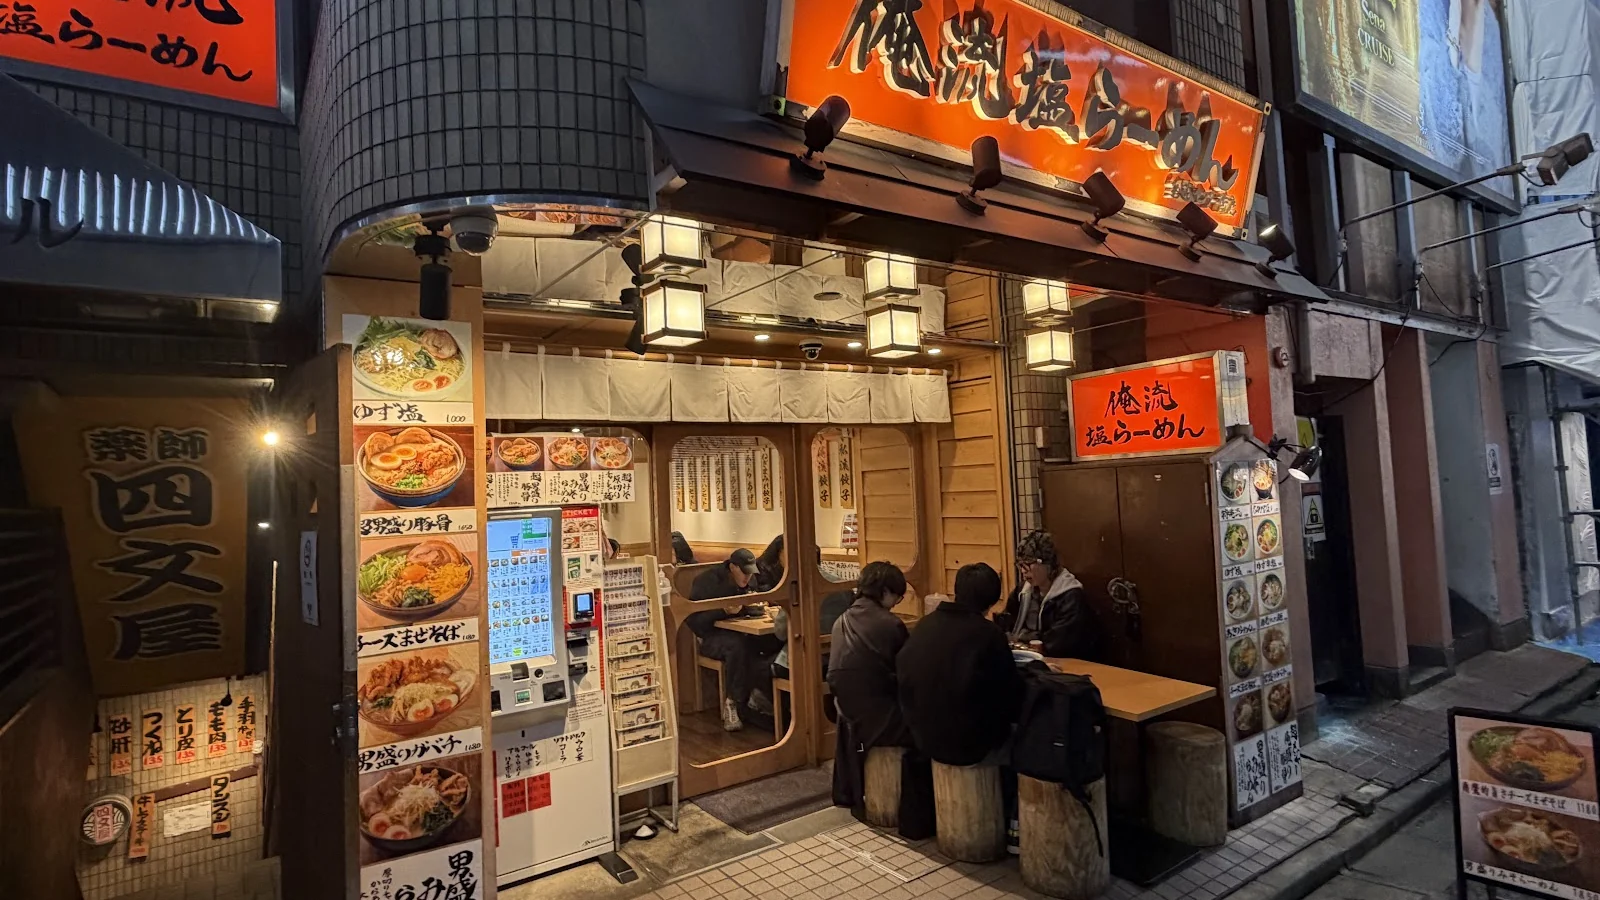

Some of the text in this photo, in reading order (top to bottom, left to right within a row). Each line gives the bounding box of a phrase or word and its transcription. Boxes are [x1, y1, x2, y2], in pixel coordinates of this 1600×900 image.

[0, 2, 253, 82] 塩らーめん
[1357, 27, 1395, 66] CRUISE
[827, 0, 1238, 190] 俺流塩らーめん
[353, 402, 427, 423] ゆず塩
[1104, 380, 1178, 418] 俺流
[87, 428, 209, 462] 薬師
[1085, 413, 1205, 447] 塩らーめん
[88, 464, 224, 660] 四文屋
[108, 716, 132, 755] 砂肝
[142, 712, 163, 757] つくね
[176, 707, 195, 751] とり皮
[143, 754, 163, 766] 135
[178, 750, 195, 760] 135
[209, 743, 227, 754] 135
